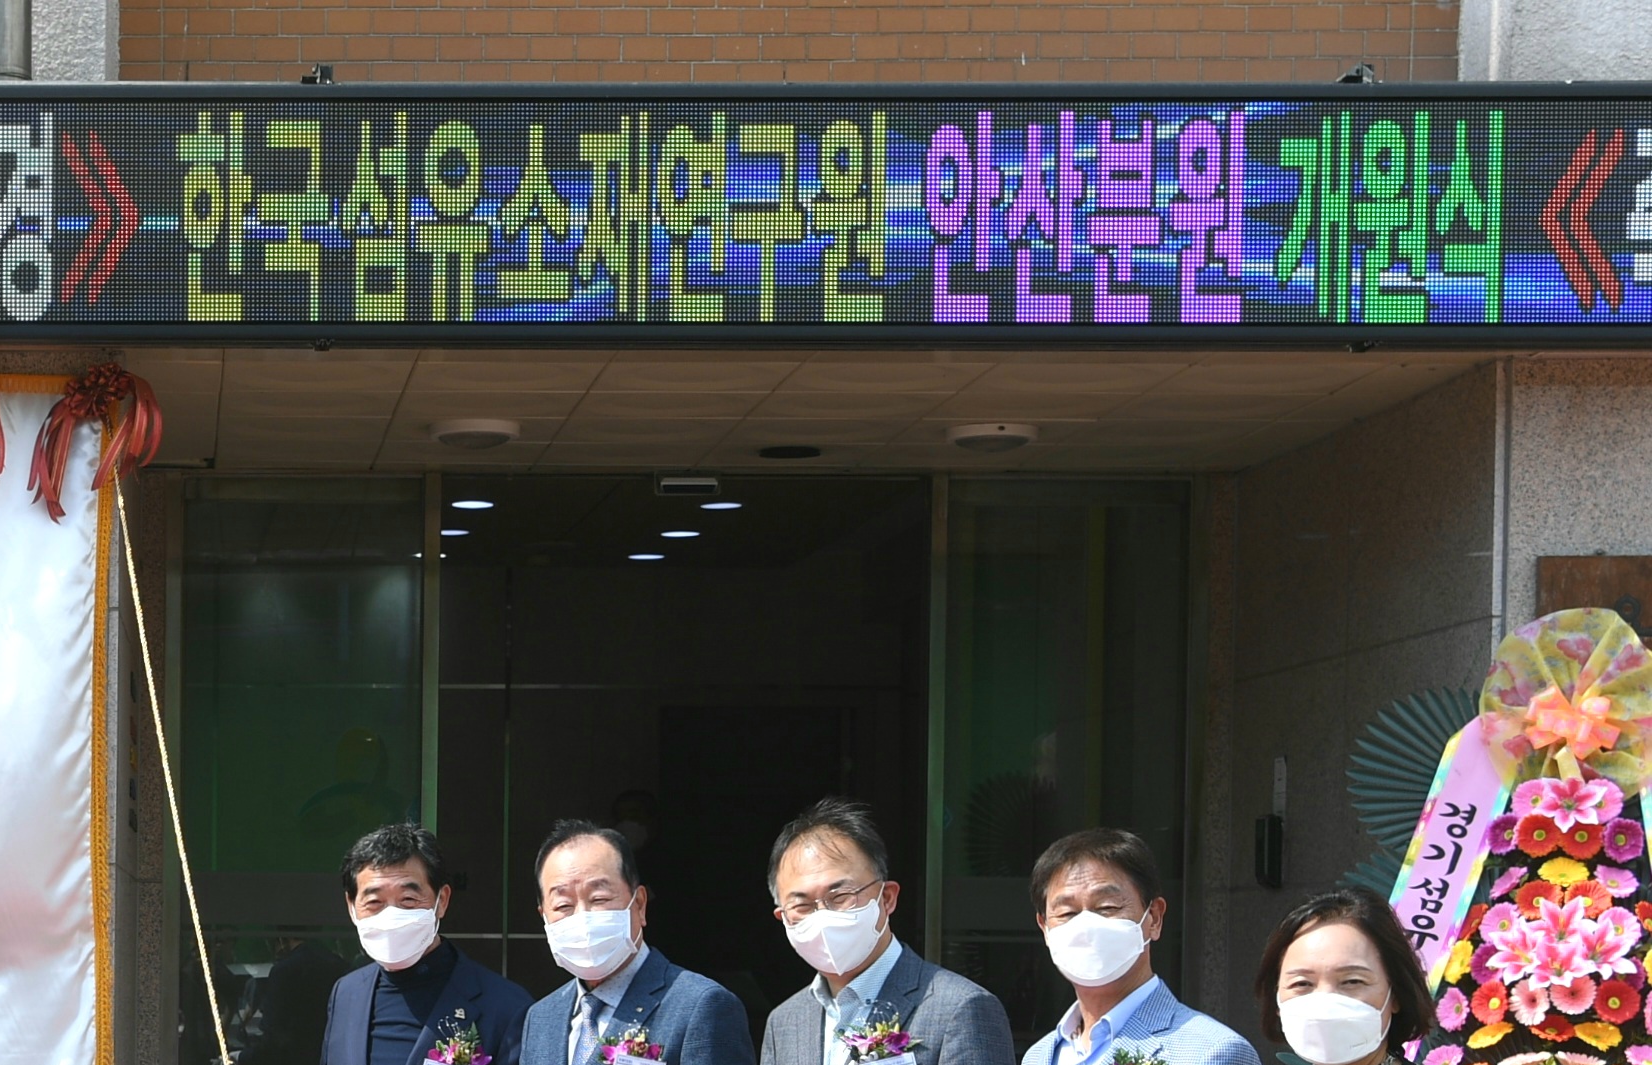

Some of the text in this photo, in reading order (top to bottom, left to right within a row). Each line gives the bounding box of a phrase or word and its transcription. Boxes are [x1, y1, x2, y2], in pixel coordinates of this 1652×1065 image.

[177, 111, 888, 323] 한국섬유소재연구원
[924, 110, 1245, 324] 안산분원
[1277, 110, 1505, 324] 개원식
